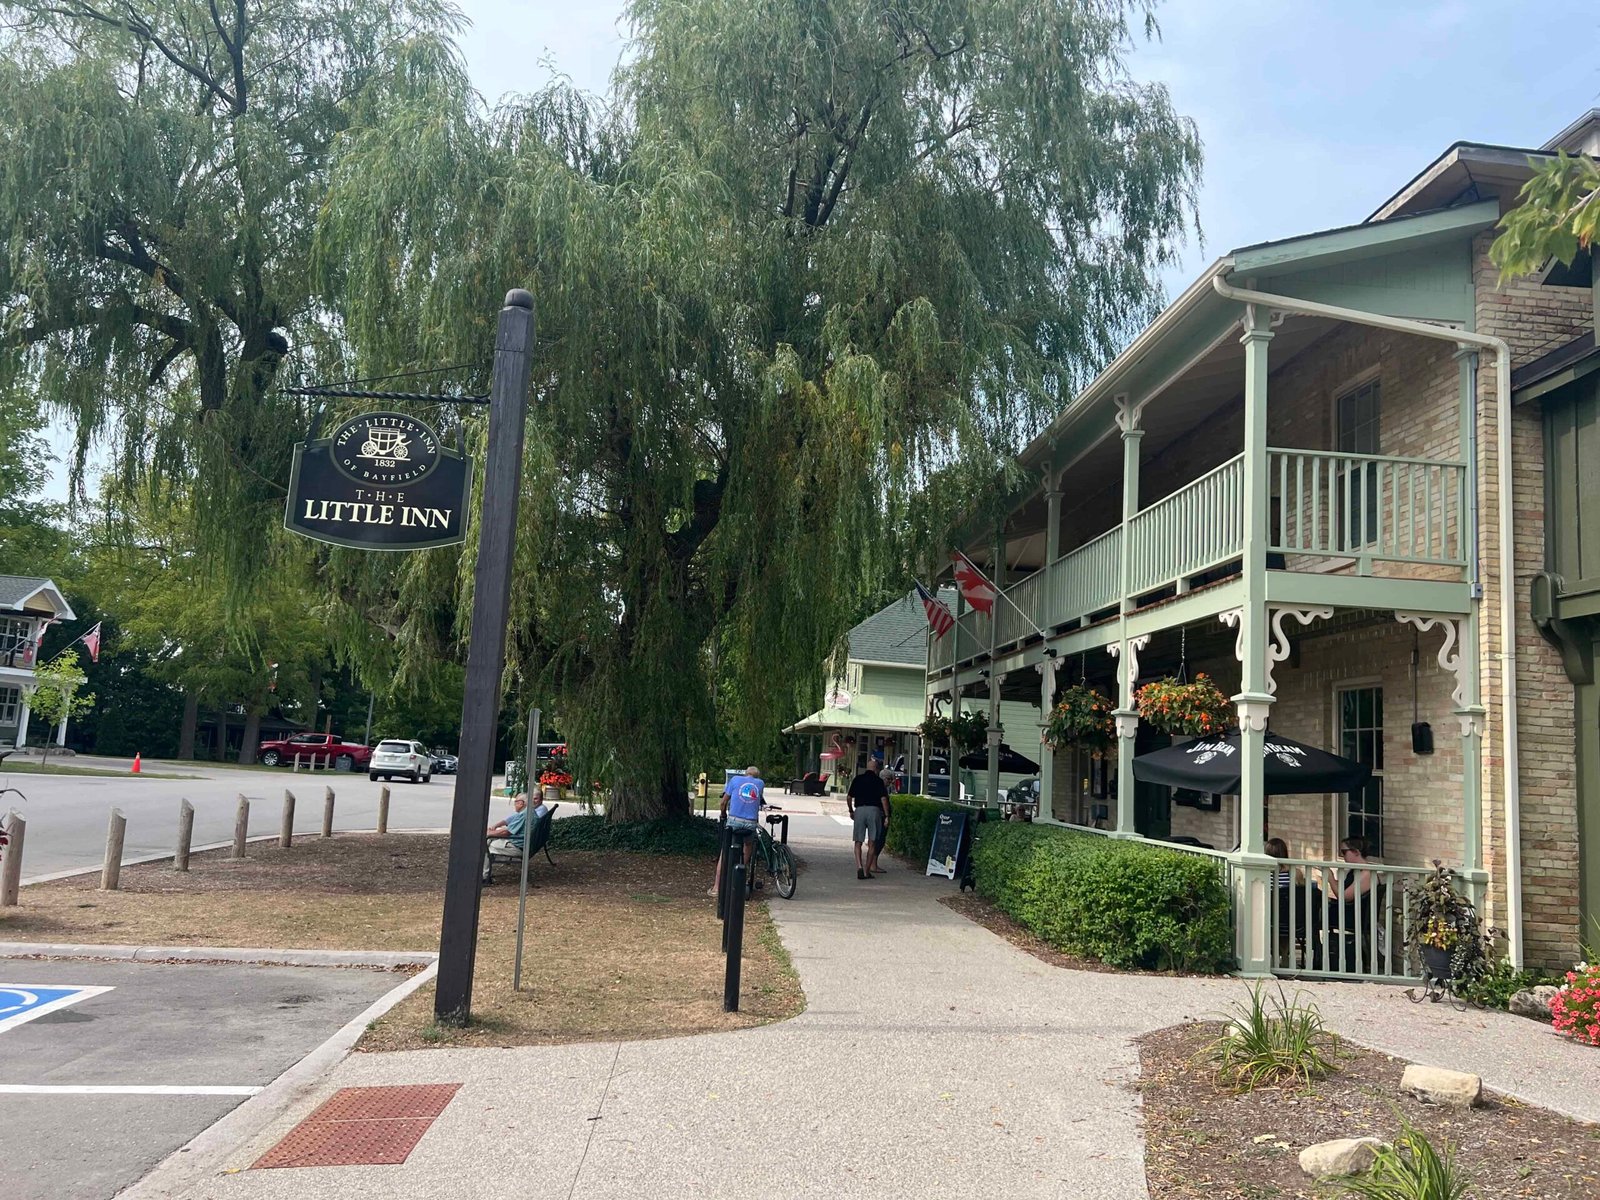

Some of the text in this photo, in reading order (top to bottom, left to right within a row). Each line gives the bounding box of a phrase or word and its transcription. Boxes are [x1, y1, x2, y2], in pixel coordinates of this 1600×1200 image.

[337, 417, 436, 454] THE LITTLE INN
[344, 458, 426, 481] OF BAYFIELD
[374, 459, 396, 468] 1832
[304, 499, 452, 529] LITTLE INN
